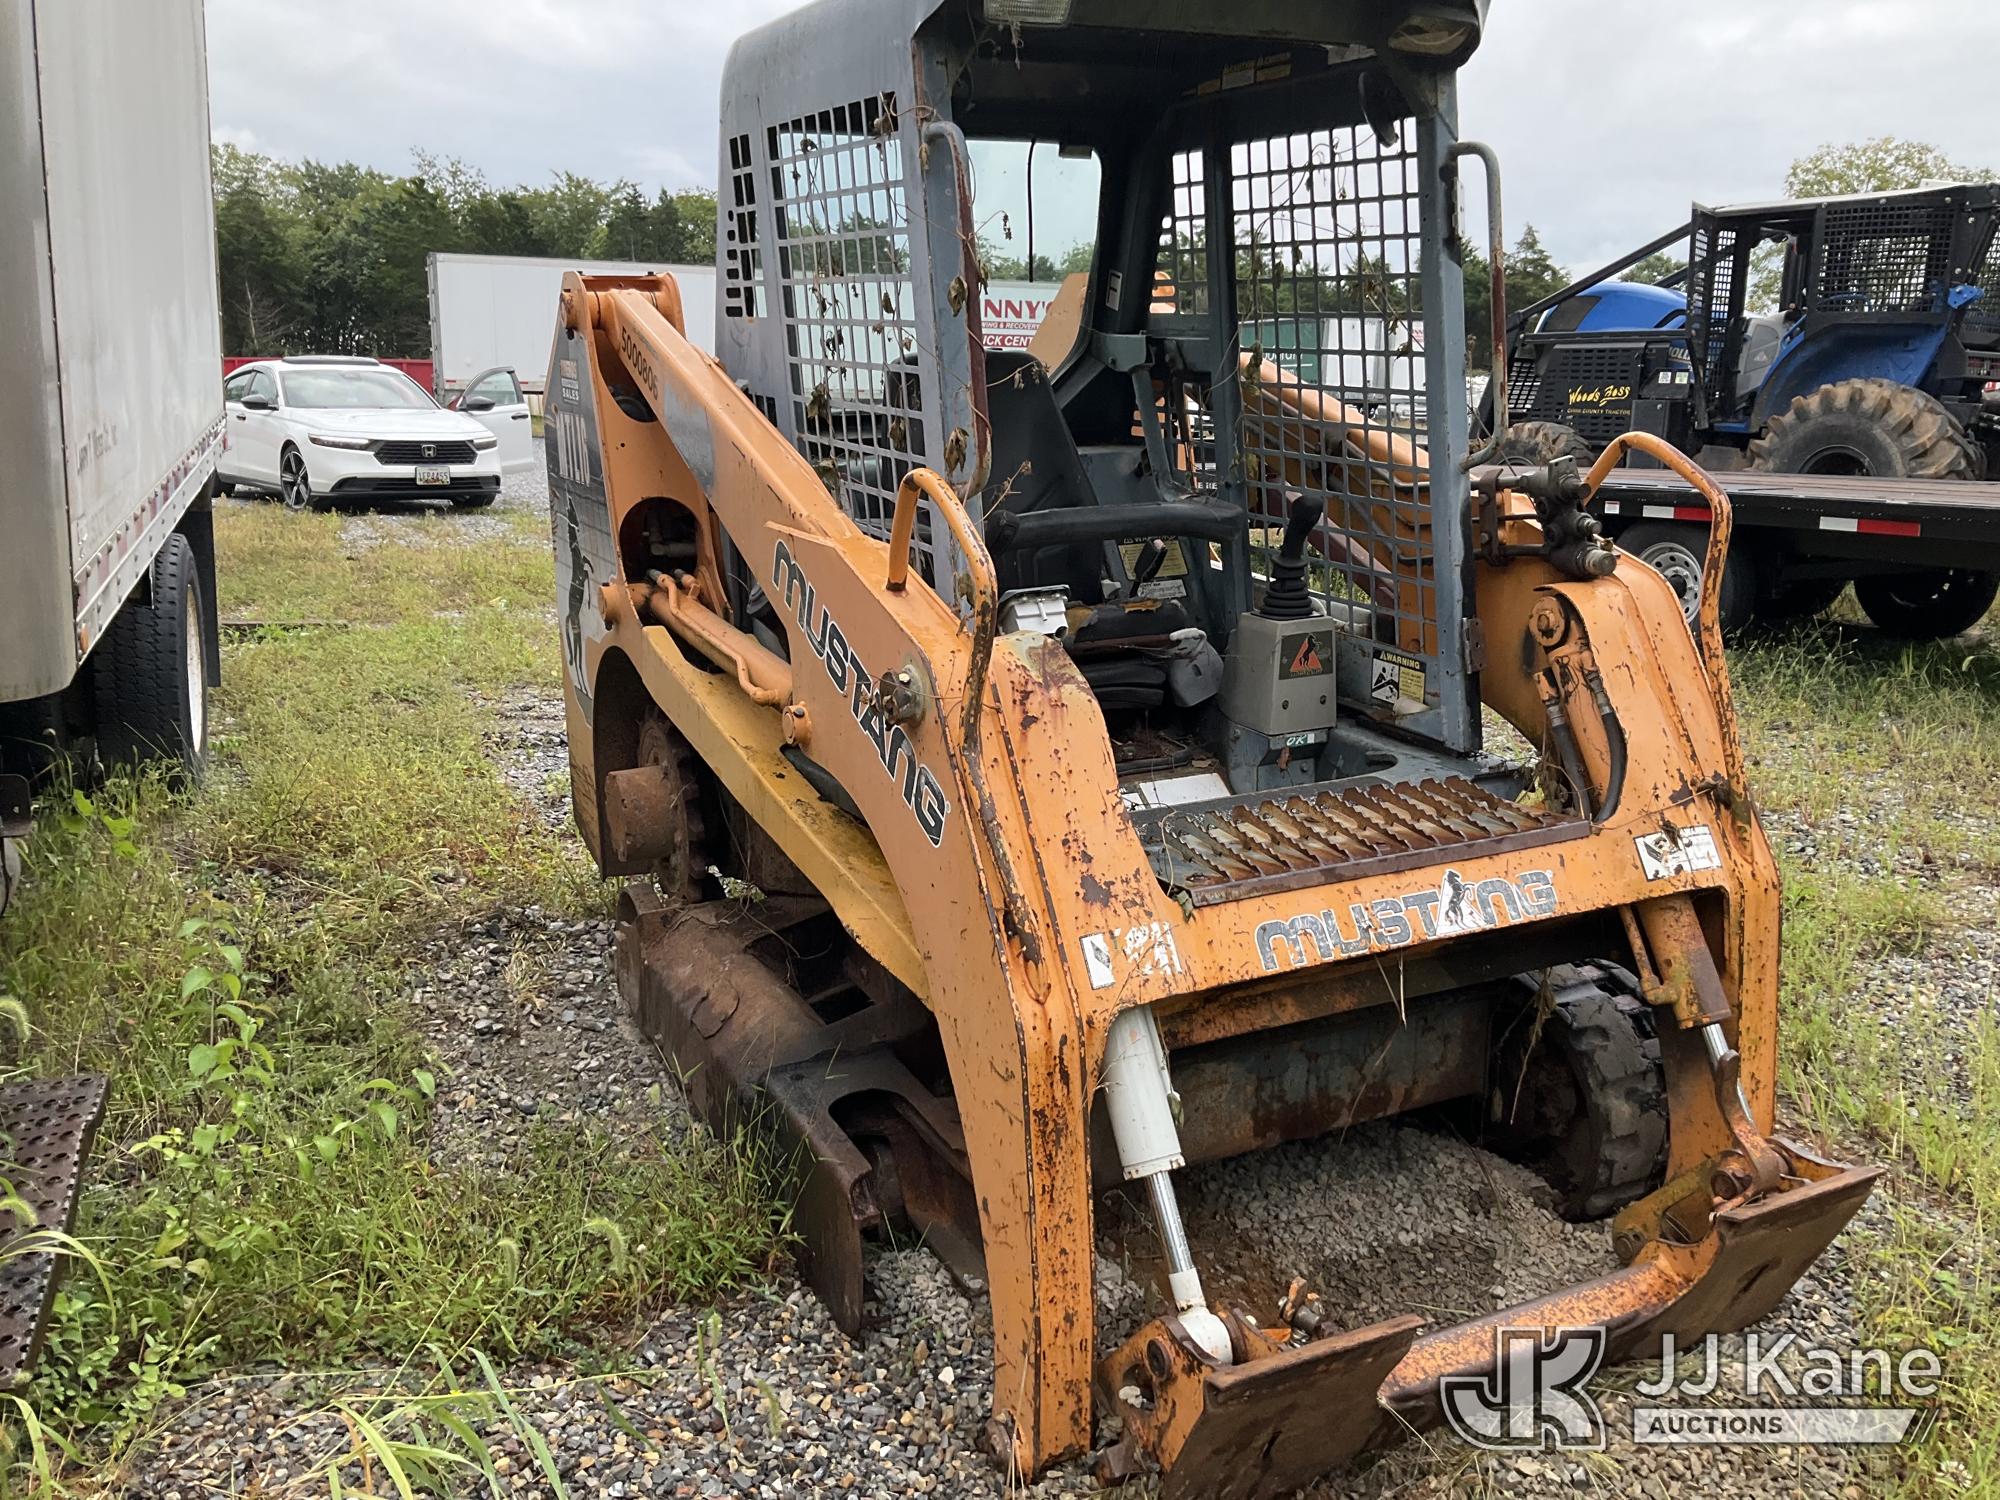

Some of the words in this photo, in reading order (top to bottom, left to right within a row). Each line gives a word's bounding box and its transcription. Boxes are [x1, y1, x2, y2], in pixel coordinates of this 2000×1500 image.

[772, 539, 946, 848] MUSTANG
[1386, 652, 1420, 669] WARNING
[1255, 868, 1557, 972] MUSTANG
